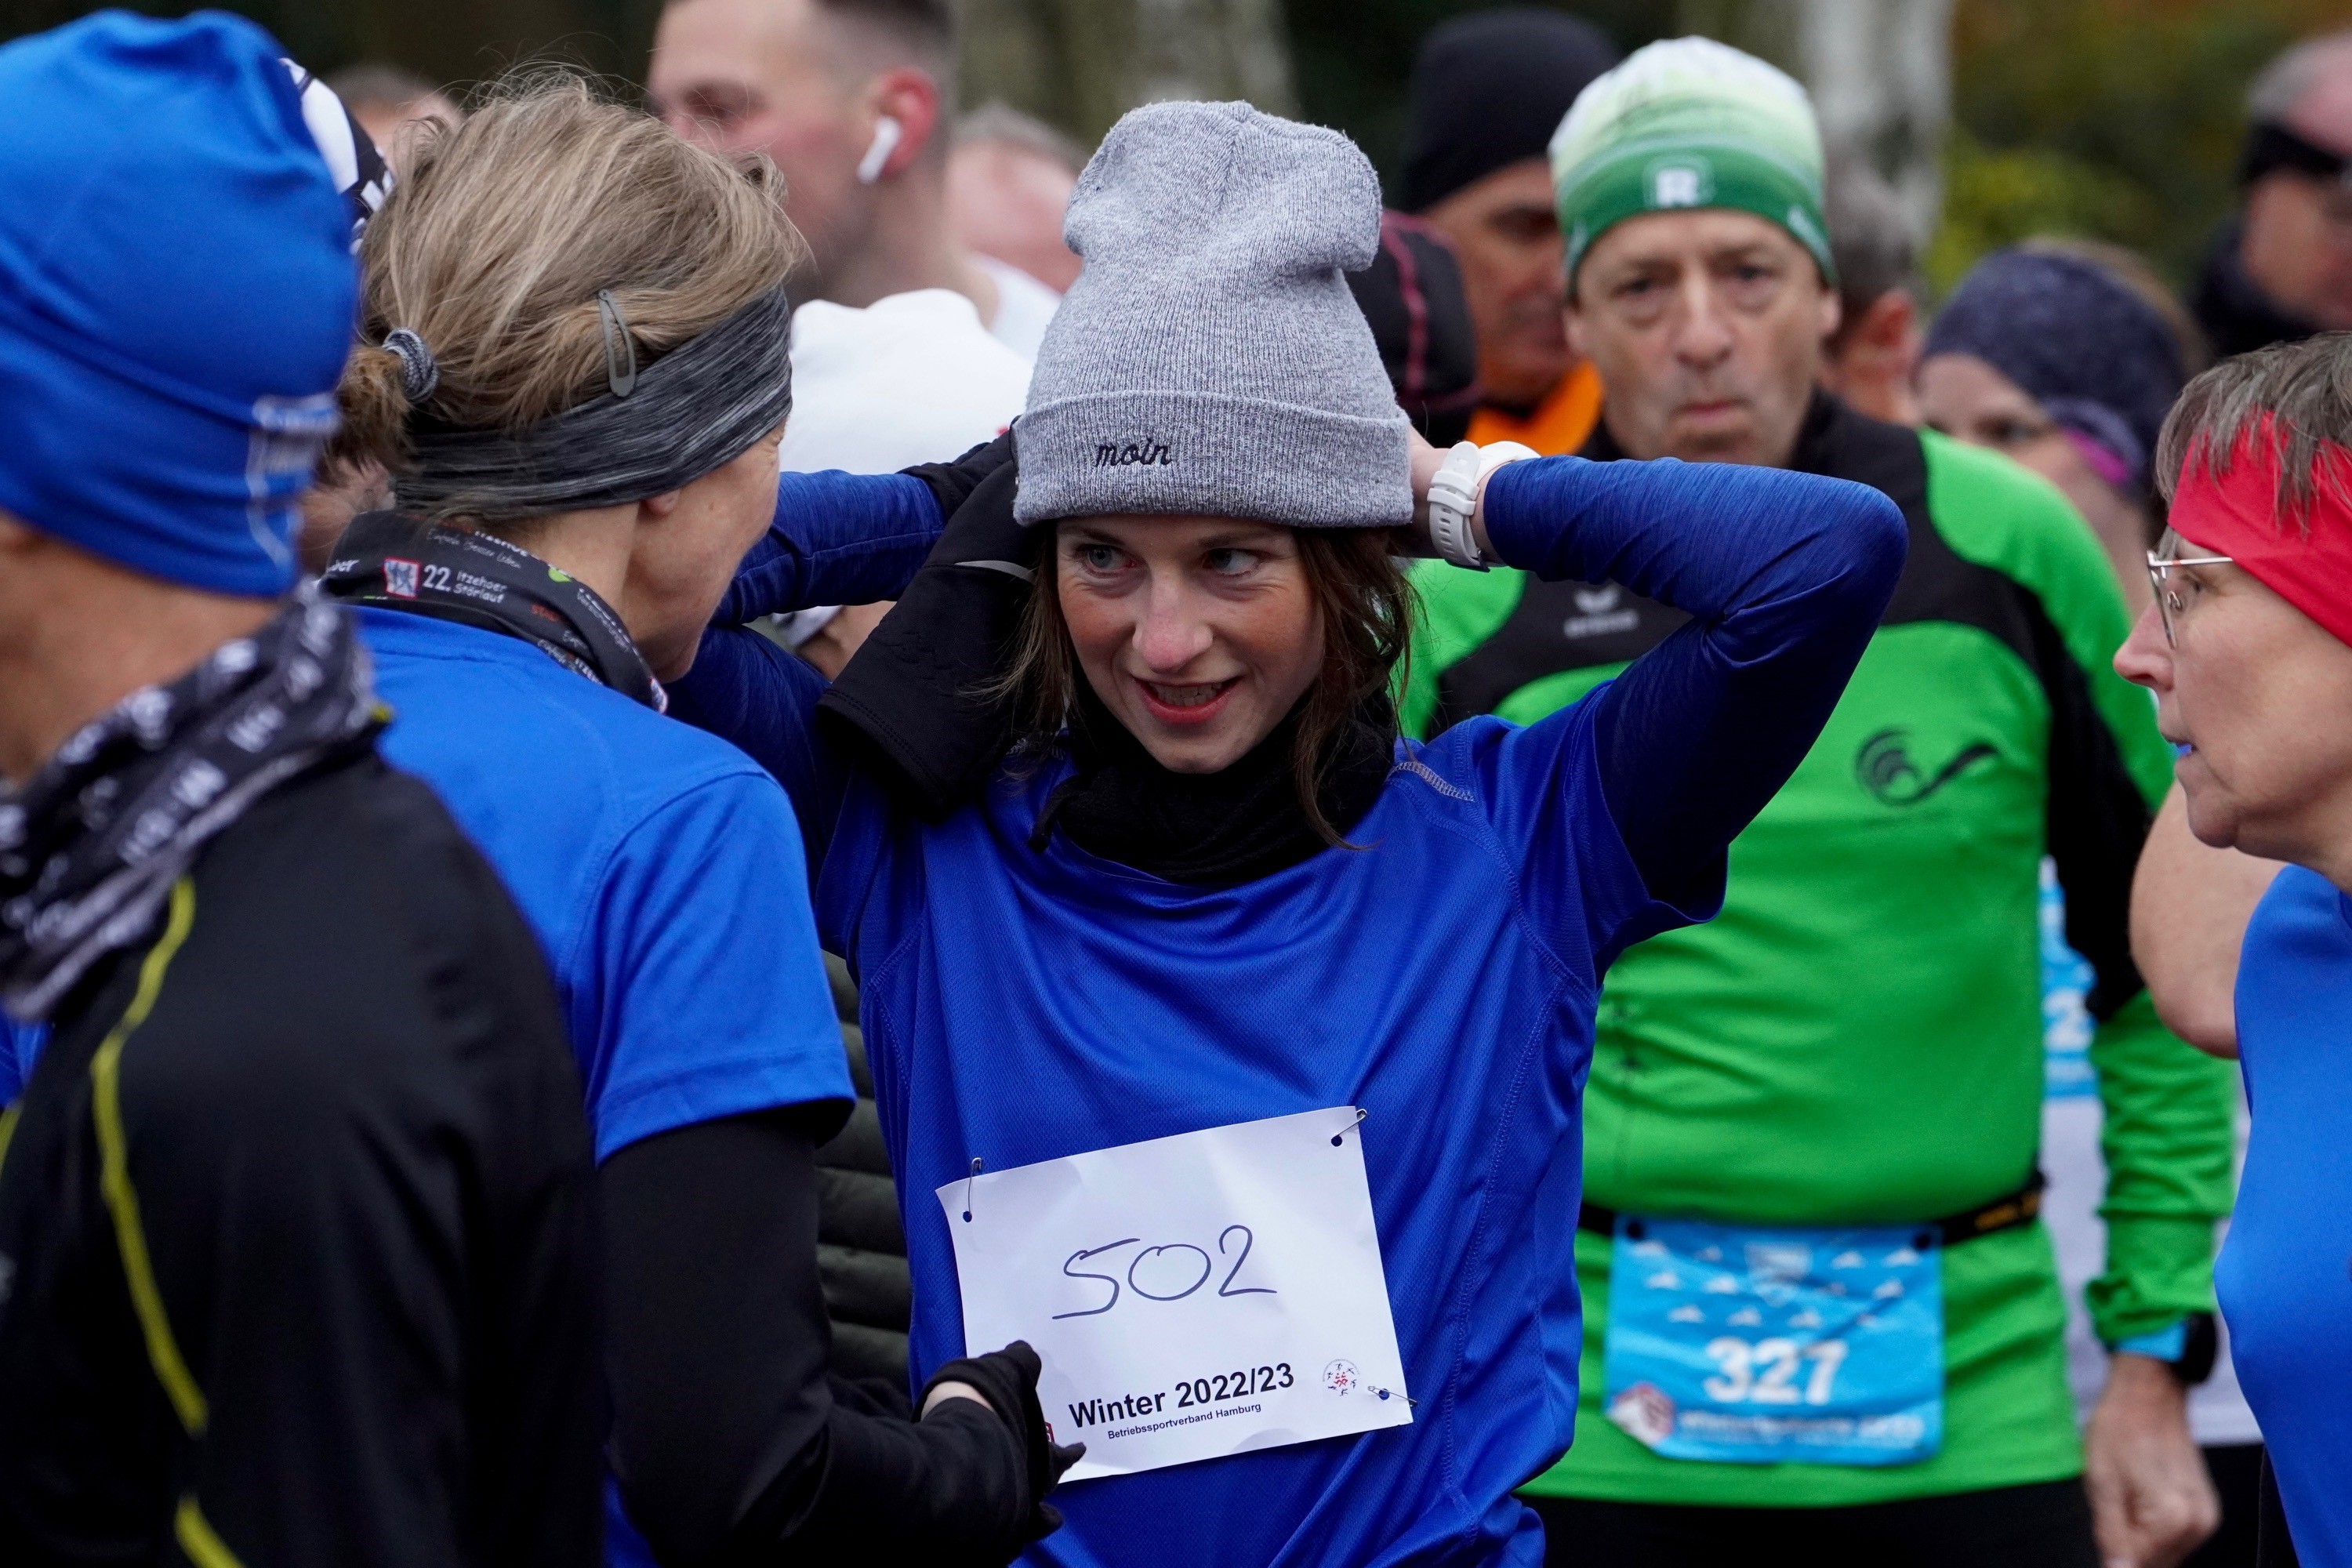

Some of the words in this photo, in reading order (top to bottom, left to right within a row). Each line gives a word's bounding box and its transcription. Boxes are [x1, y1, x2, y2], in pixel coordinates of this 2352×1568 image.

[1094, 438, 1171, 466] moin
[423, 564, 452, 592] 22.
[1052, 1224, 1277, 1320] 502
[1069, 1392, 1167, 1428] Winter
[1174, 1363, 1295, 1409] 2022/23
[1703, 1336, 1849, 1406] 327
[1107, 1412, 1214, 1439] Betriebssportverband
[1215, 1403, 1261, 1418] Hamburg
